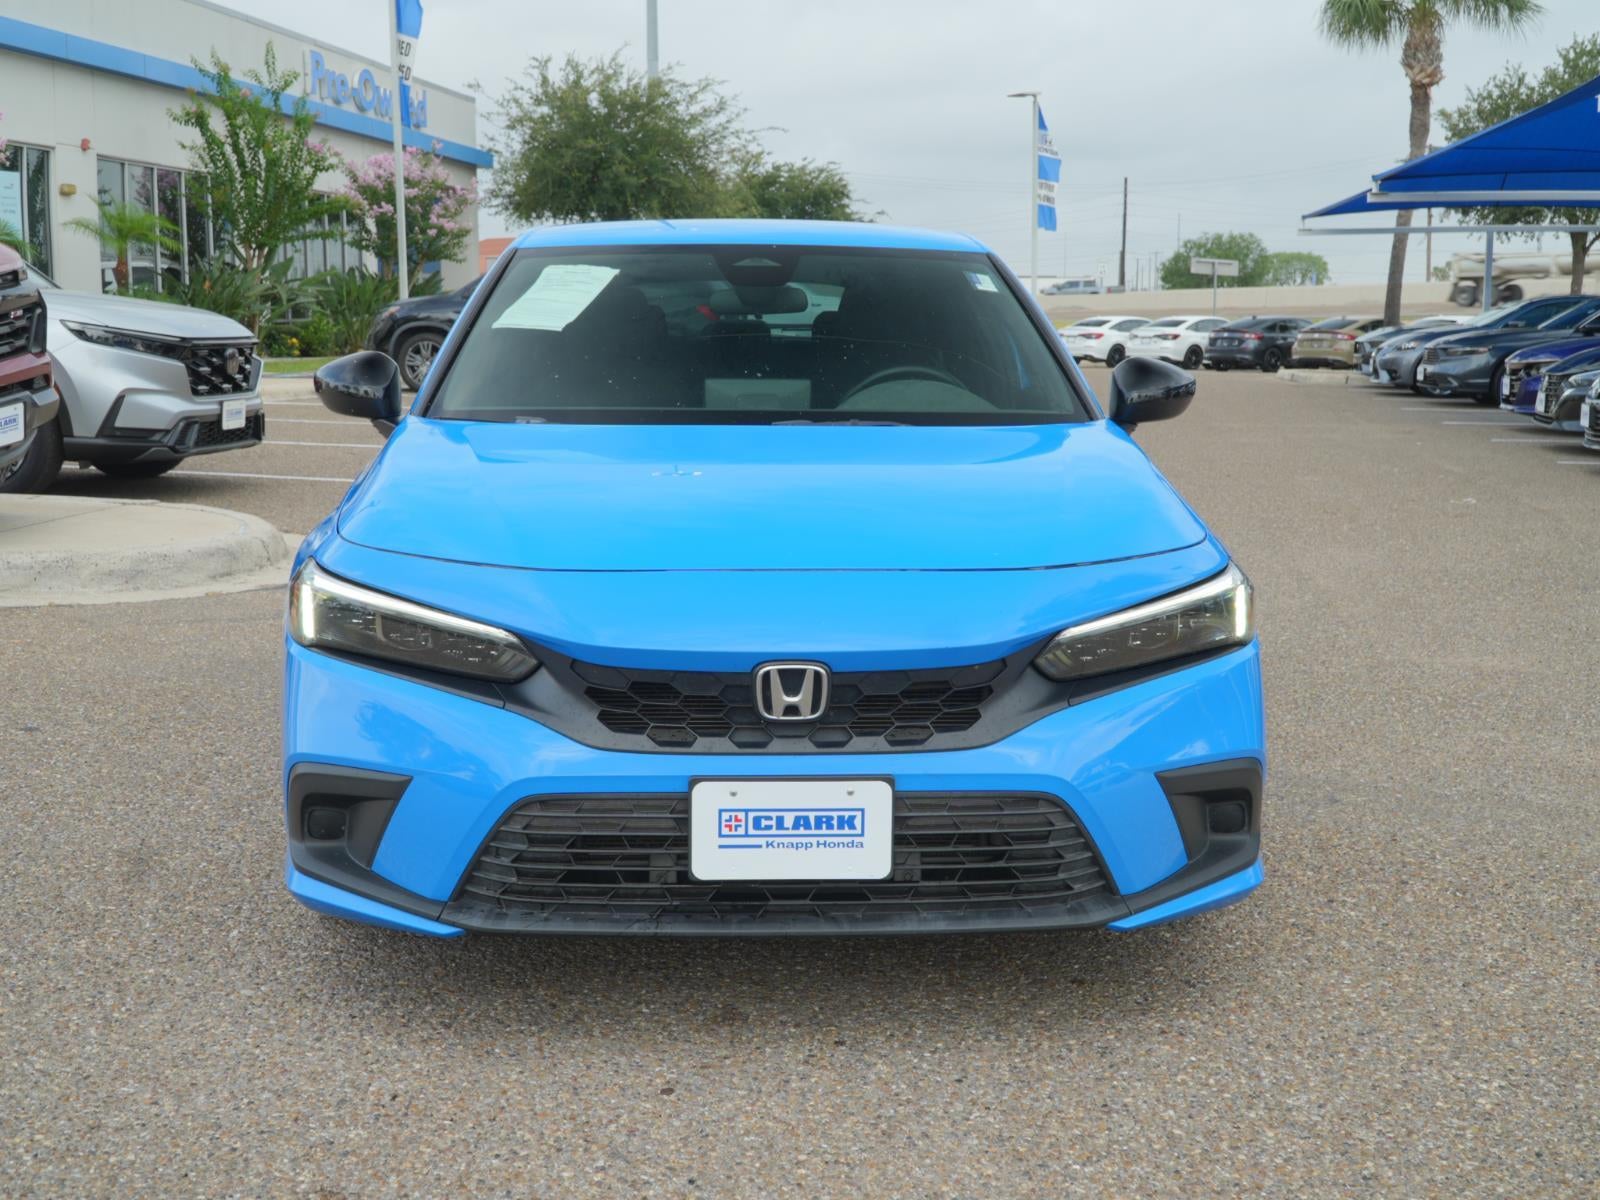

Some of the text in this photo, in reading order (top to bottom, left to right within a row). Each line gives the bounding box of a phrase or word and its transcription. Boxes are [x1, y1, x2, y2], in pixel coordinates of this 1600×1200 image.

[309, 50, 428, 128] Pre-Owd
[752, 814, 858, 831] CLARK
[765, 840, 864, 850] Knapp Honda
